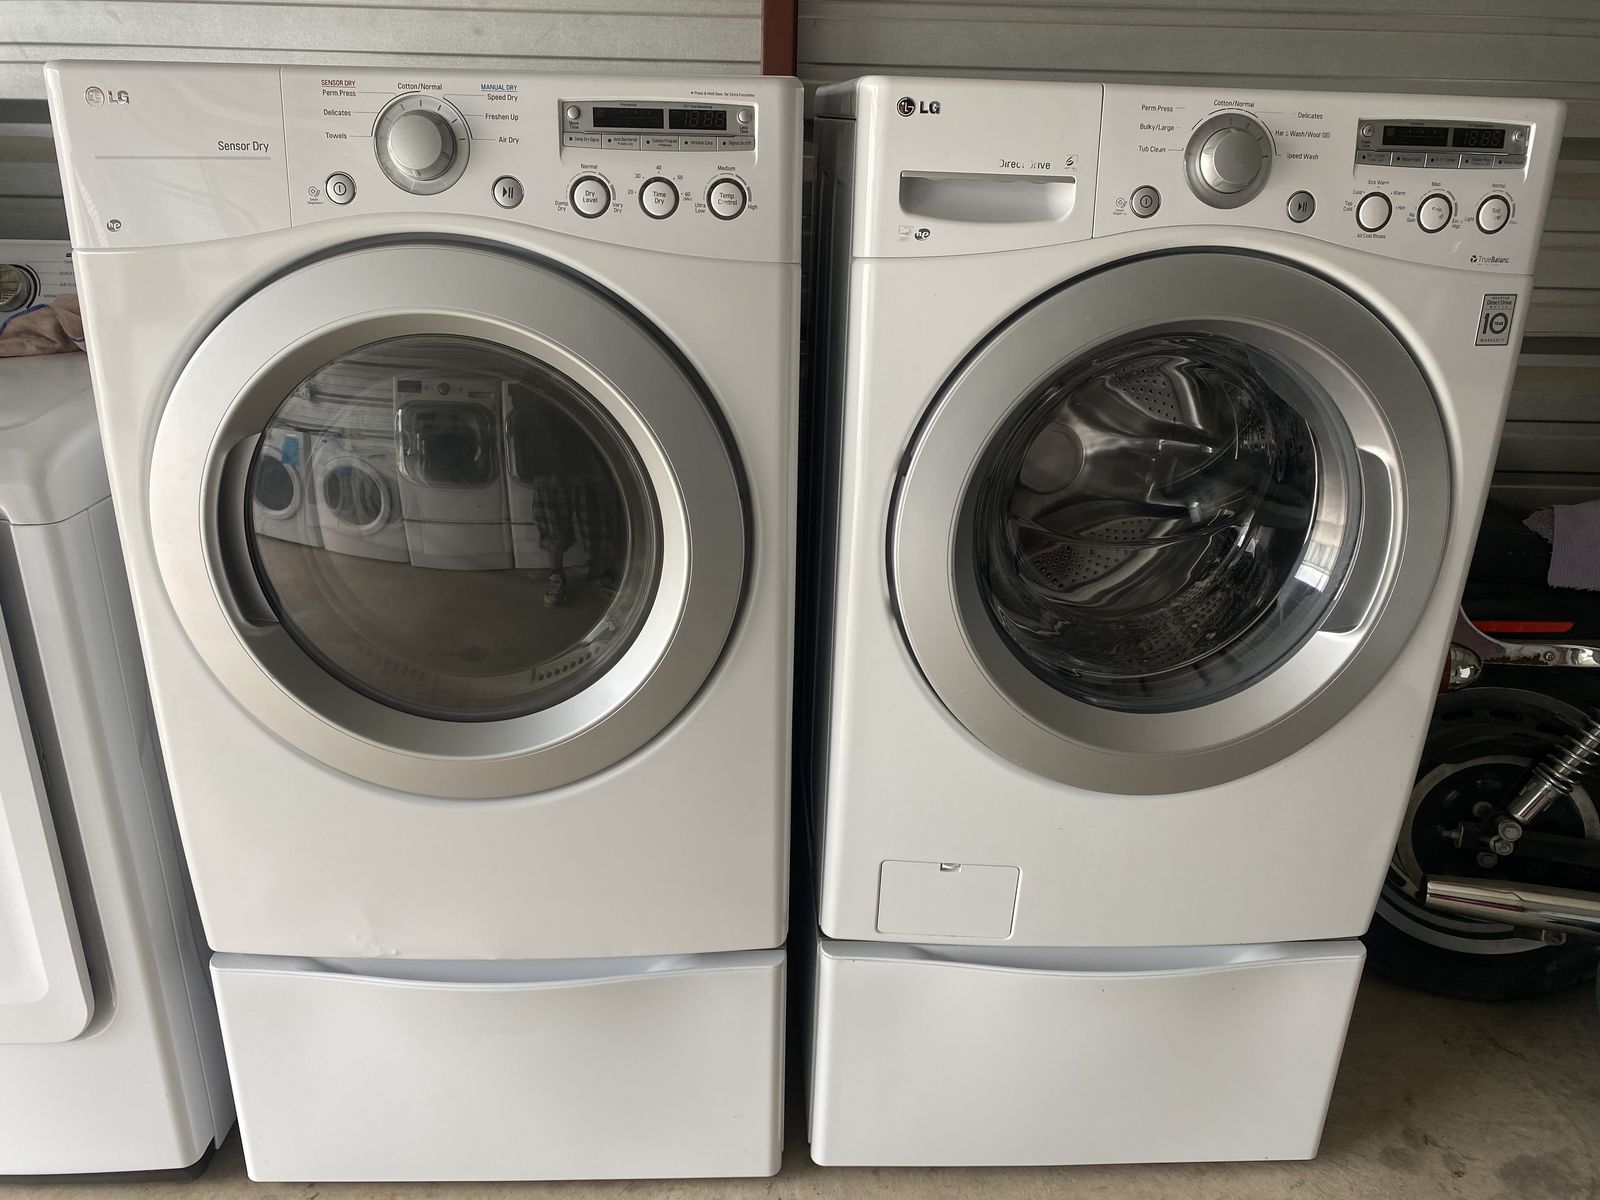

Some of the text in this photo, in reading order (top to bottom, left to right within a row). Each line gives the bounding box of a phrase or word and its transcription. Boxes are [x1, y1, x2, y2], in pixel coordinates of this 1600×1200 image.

[321, 79, 343, 87] SENSOR
[397, 82, 443, 91] Cotton/Normal
[480, 83, 505, 91] MANUAL
[487, 93, 519, 102] Speed Dry
[919, 100, 941, 114] LG
[1213, 99, 1255, 107] Cotton/Normal
[323, 108, 351, 117] Delicates
[1297, 111, 1323, 119] Delicates
[485, 112, 519, 122] Freshen Up
[1139, 122, 1174, 132] Bulky/Large
[325, 132, 347, 140] Towels
[508, 136, 520, 144] Dry
[217, 140, 269, 153] Sensor Dry
[1139, 145, 1149, 153] Tub
[654, 197, 665, 205] Dry
[614, 206, 623, 214] Dry
[1482, 312, 1509, 335] 10
